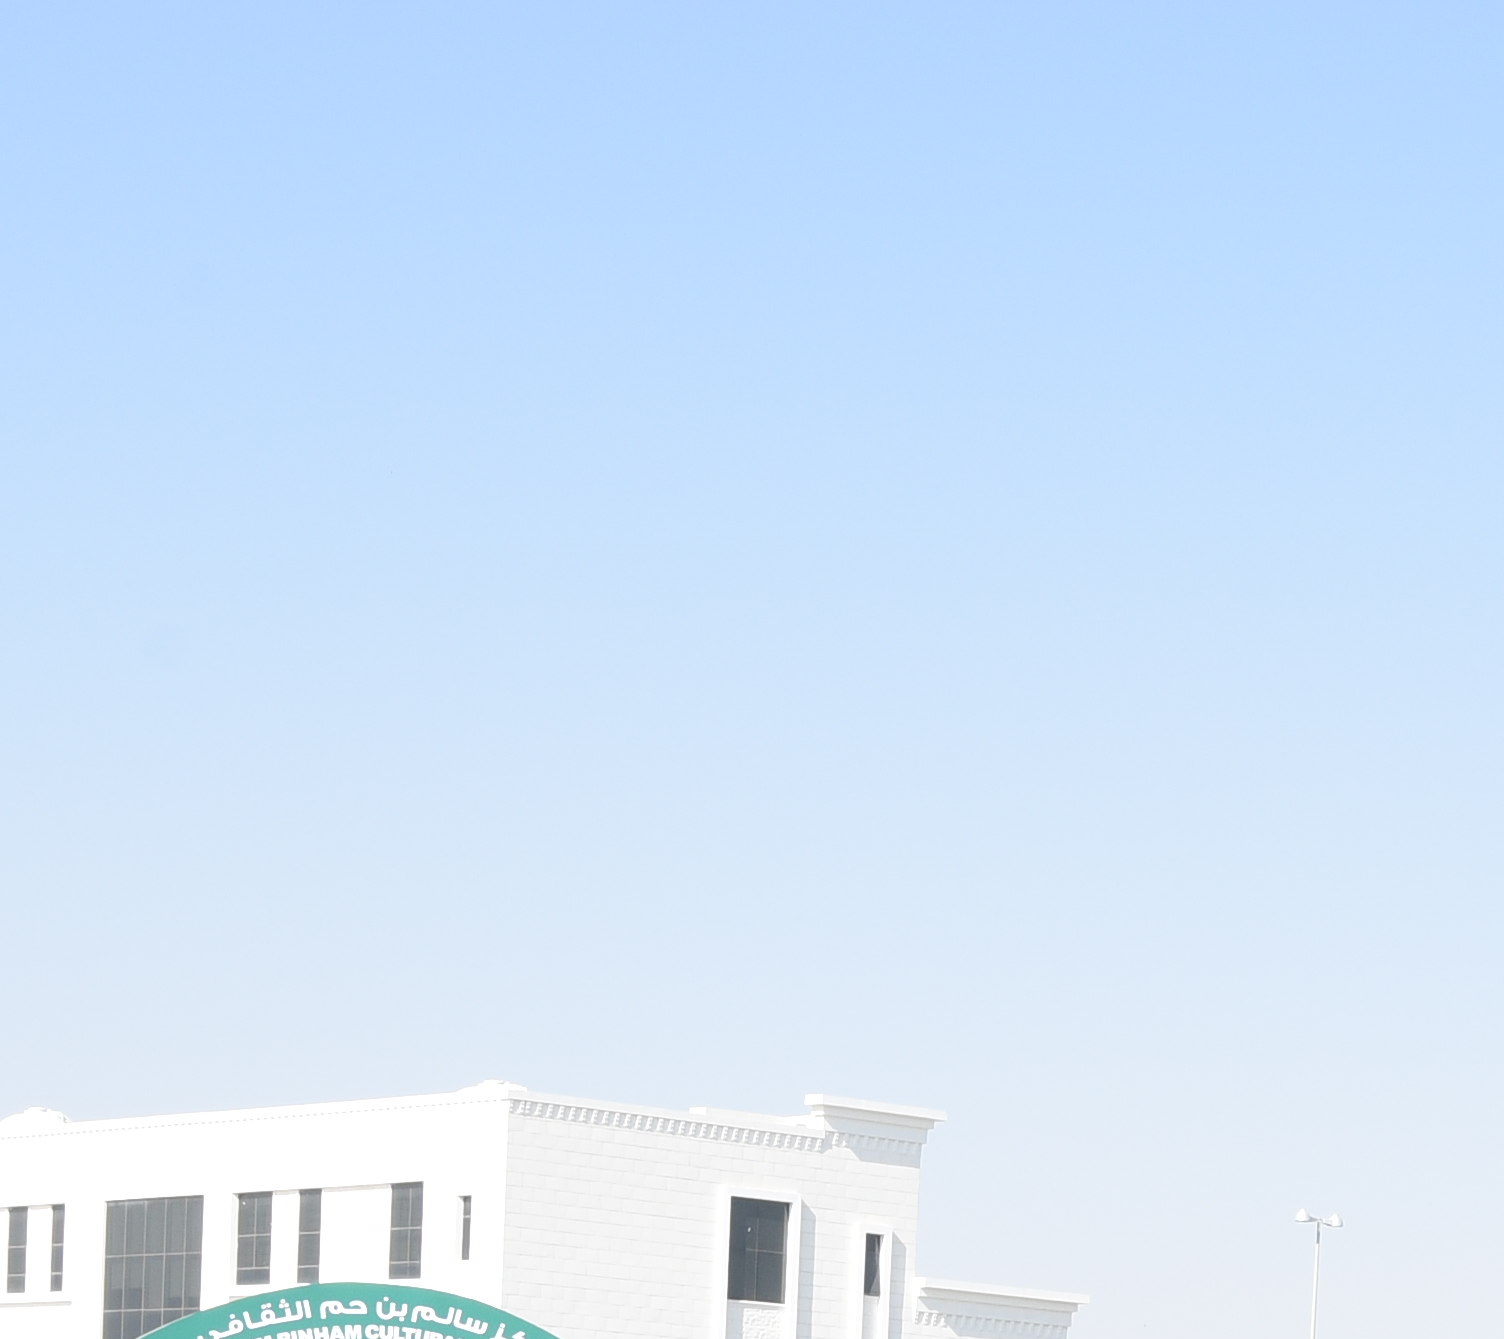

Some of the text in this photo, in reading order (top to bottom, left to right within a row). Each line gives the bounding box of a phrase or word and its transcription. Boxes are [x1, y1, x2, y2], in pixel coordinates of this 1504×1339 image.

[319, 1300, 368, 1320] حم
[376, 1296, 408, 1322] بن
[410, 1305, 489, 1335] سالم
